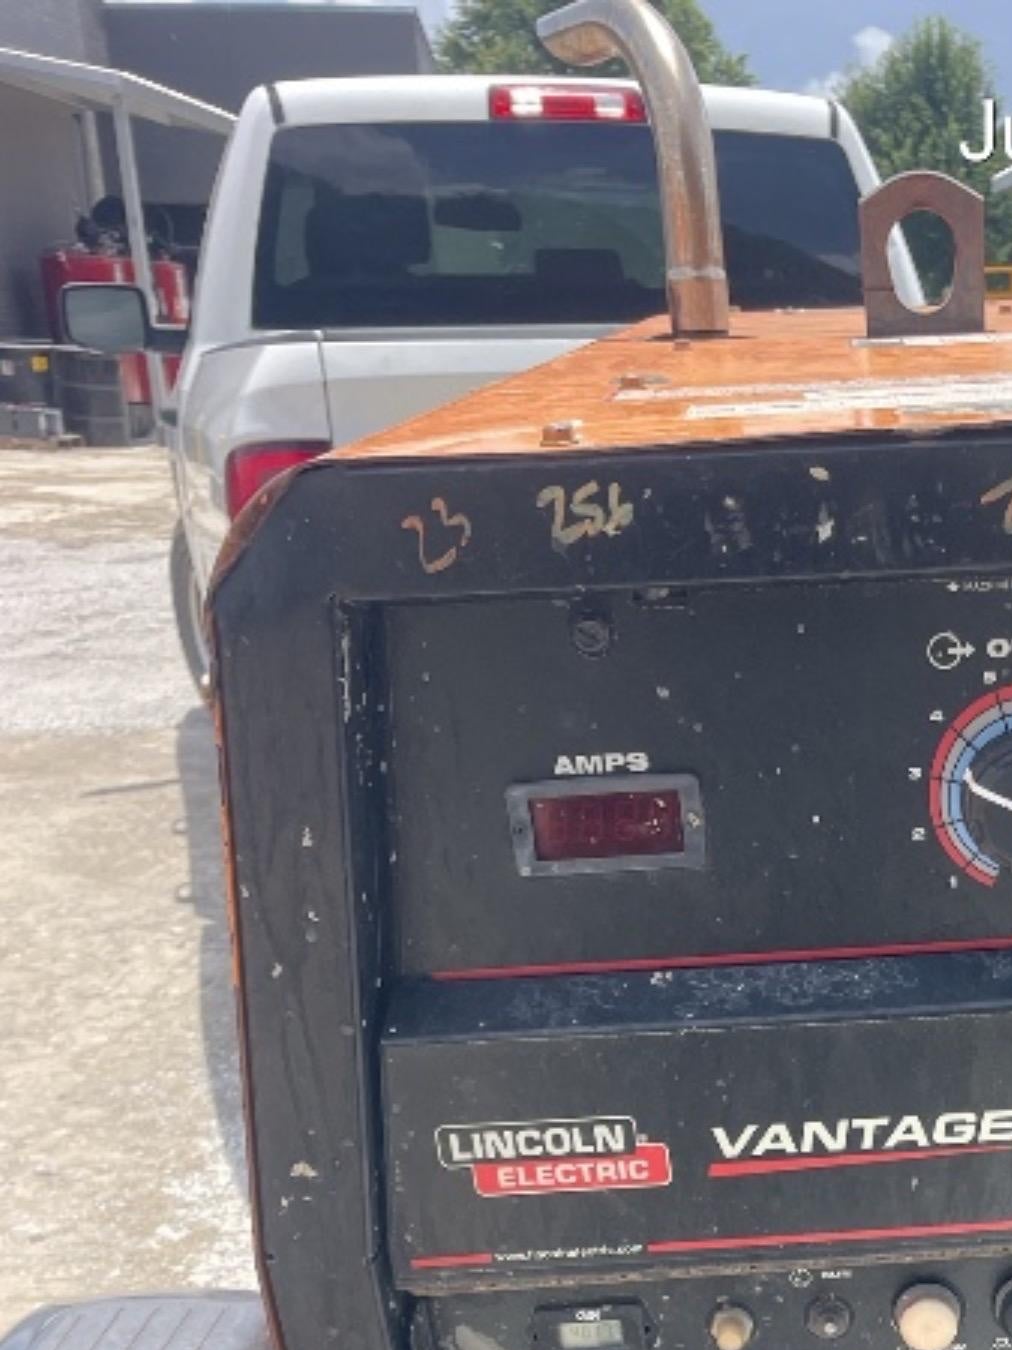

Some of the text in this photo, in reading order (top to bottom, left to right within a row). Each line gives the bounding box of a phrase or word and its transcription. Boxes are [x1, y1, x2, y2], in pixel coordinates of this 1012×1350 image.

[536, 480, 634, 545] 256
[401, 497, 472, 575] 23
[554, 751, 650, 776] AMPS
[449, 1123, 627, 1161] LINCOLN
[496, 1158, 650, 1189] ELECTRIC
